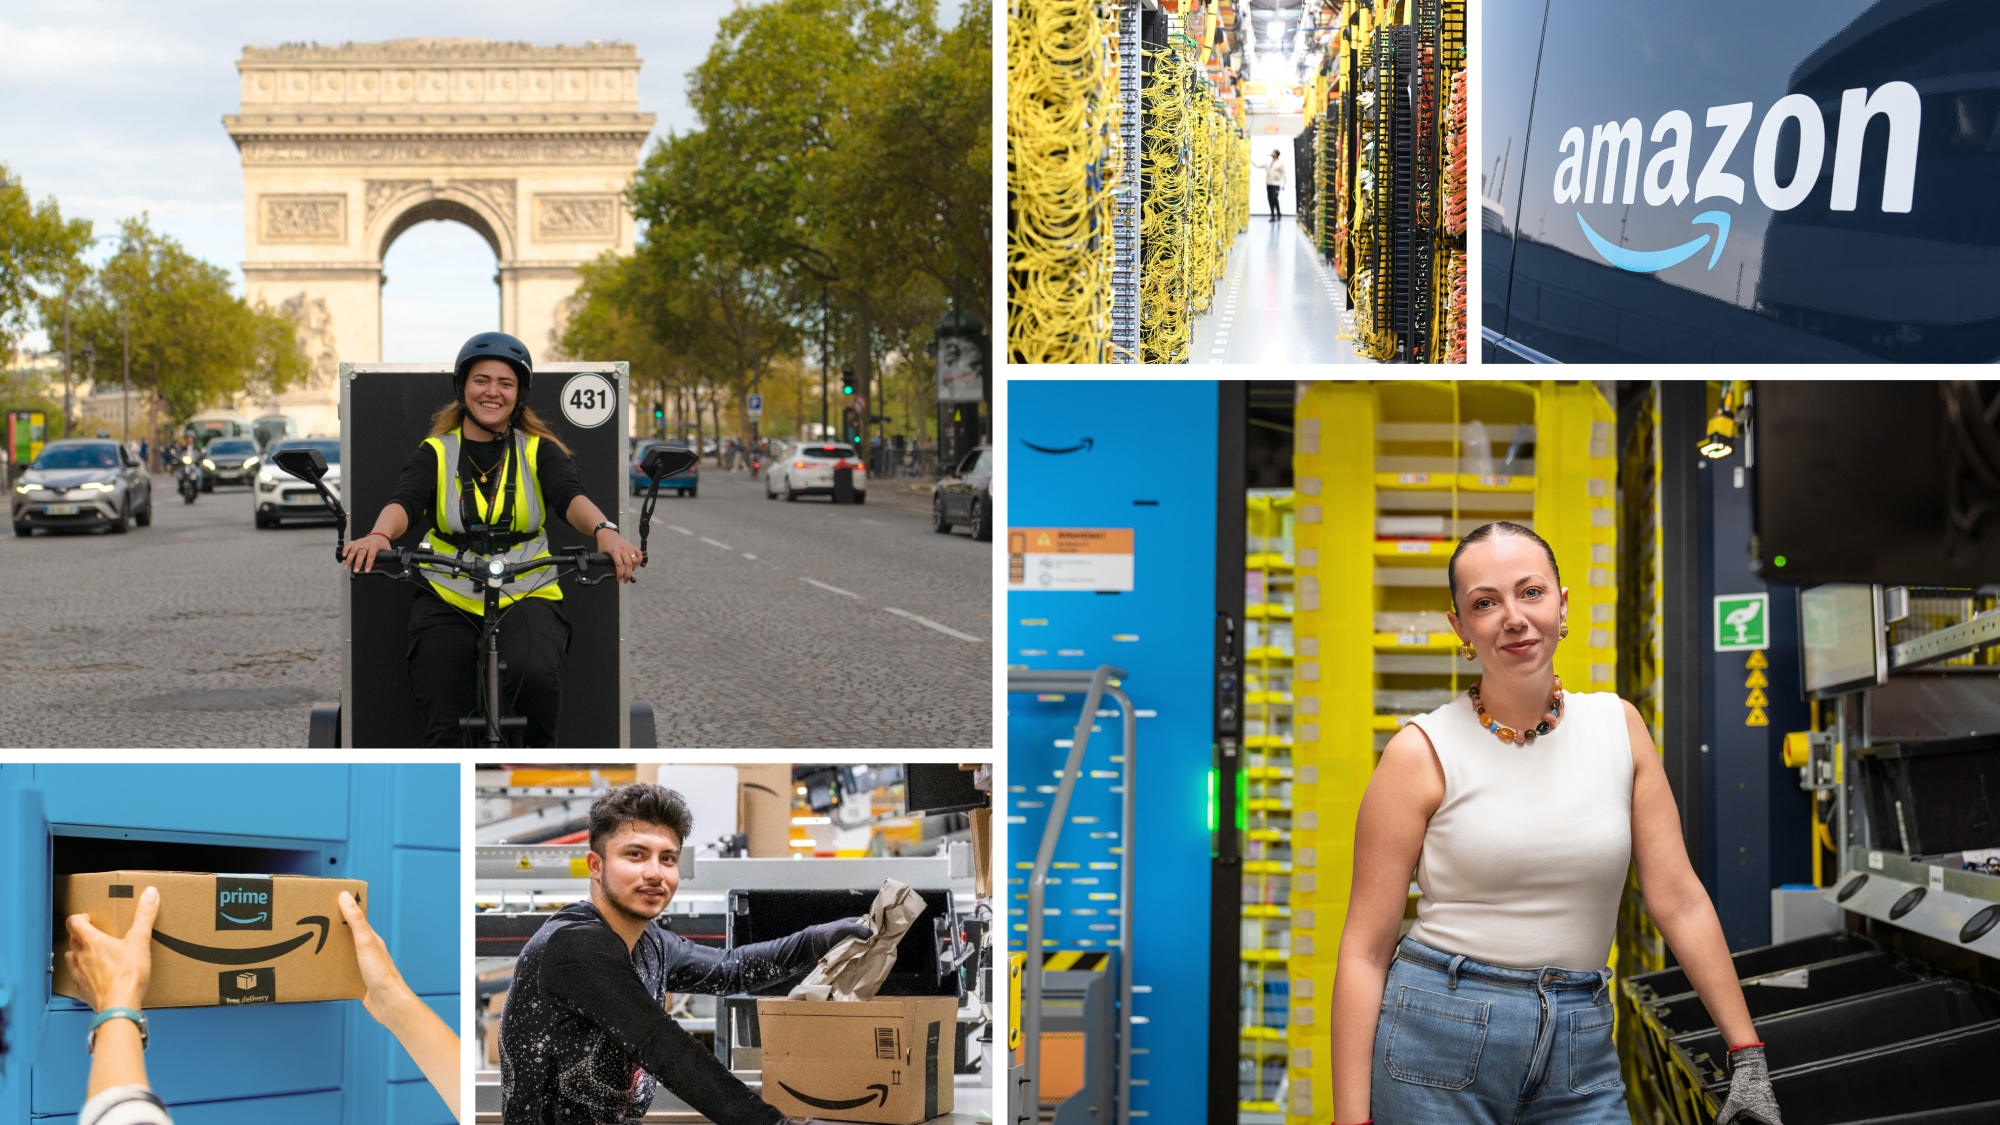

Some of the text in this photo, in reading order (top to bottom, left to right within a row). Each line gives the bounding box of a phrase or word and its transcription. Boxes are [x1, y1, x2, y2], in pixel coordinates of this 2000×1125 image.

[1553, 81, 1922, 213] amazon
[570, 389, 606, 410] 431
[220, 887, 268, 907] prime
[241, 995, 269, 1003] delivery
